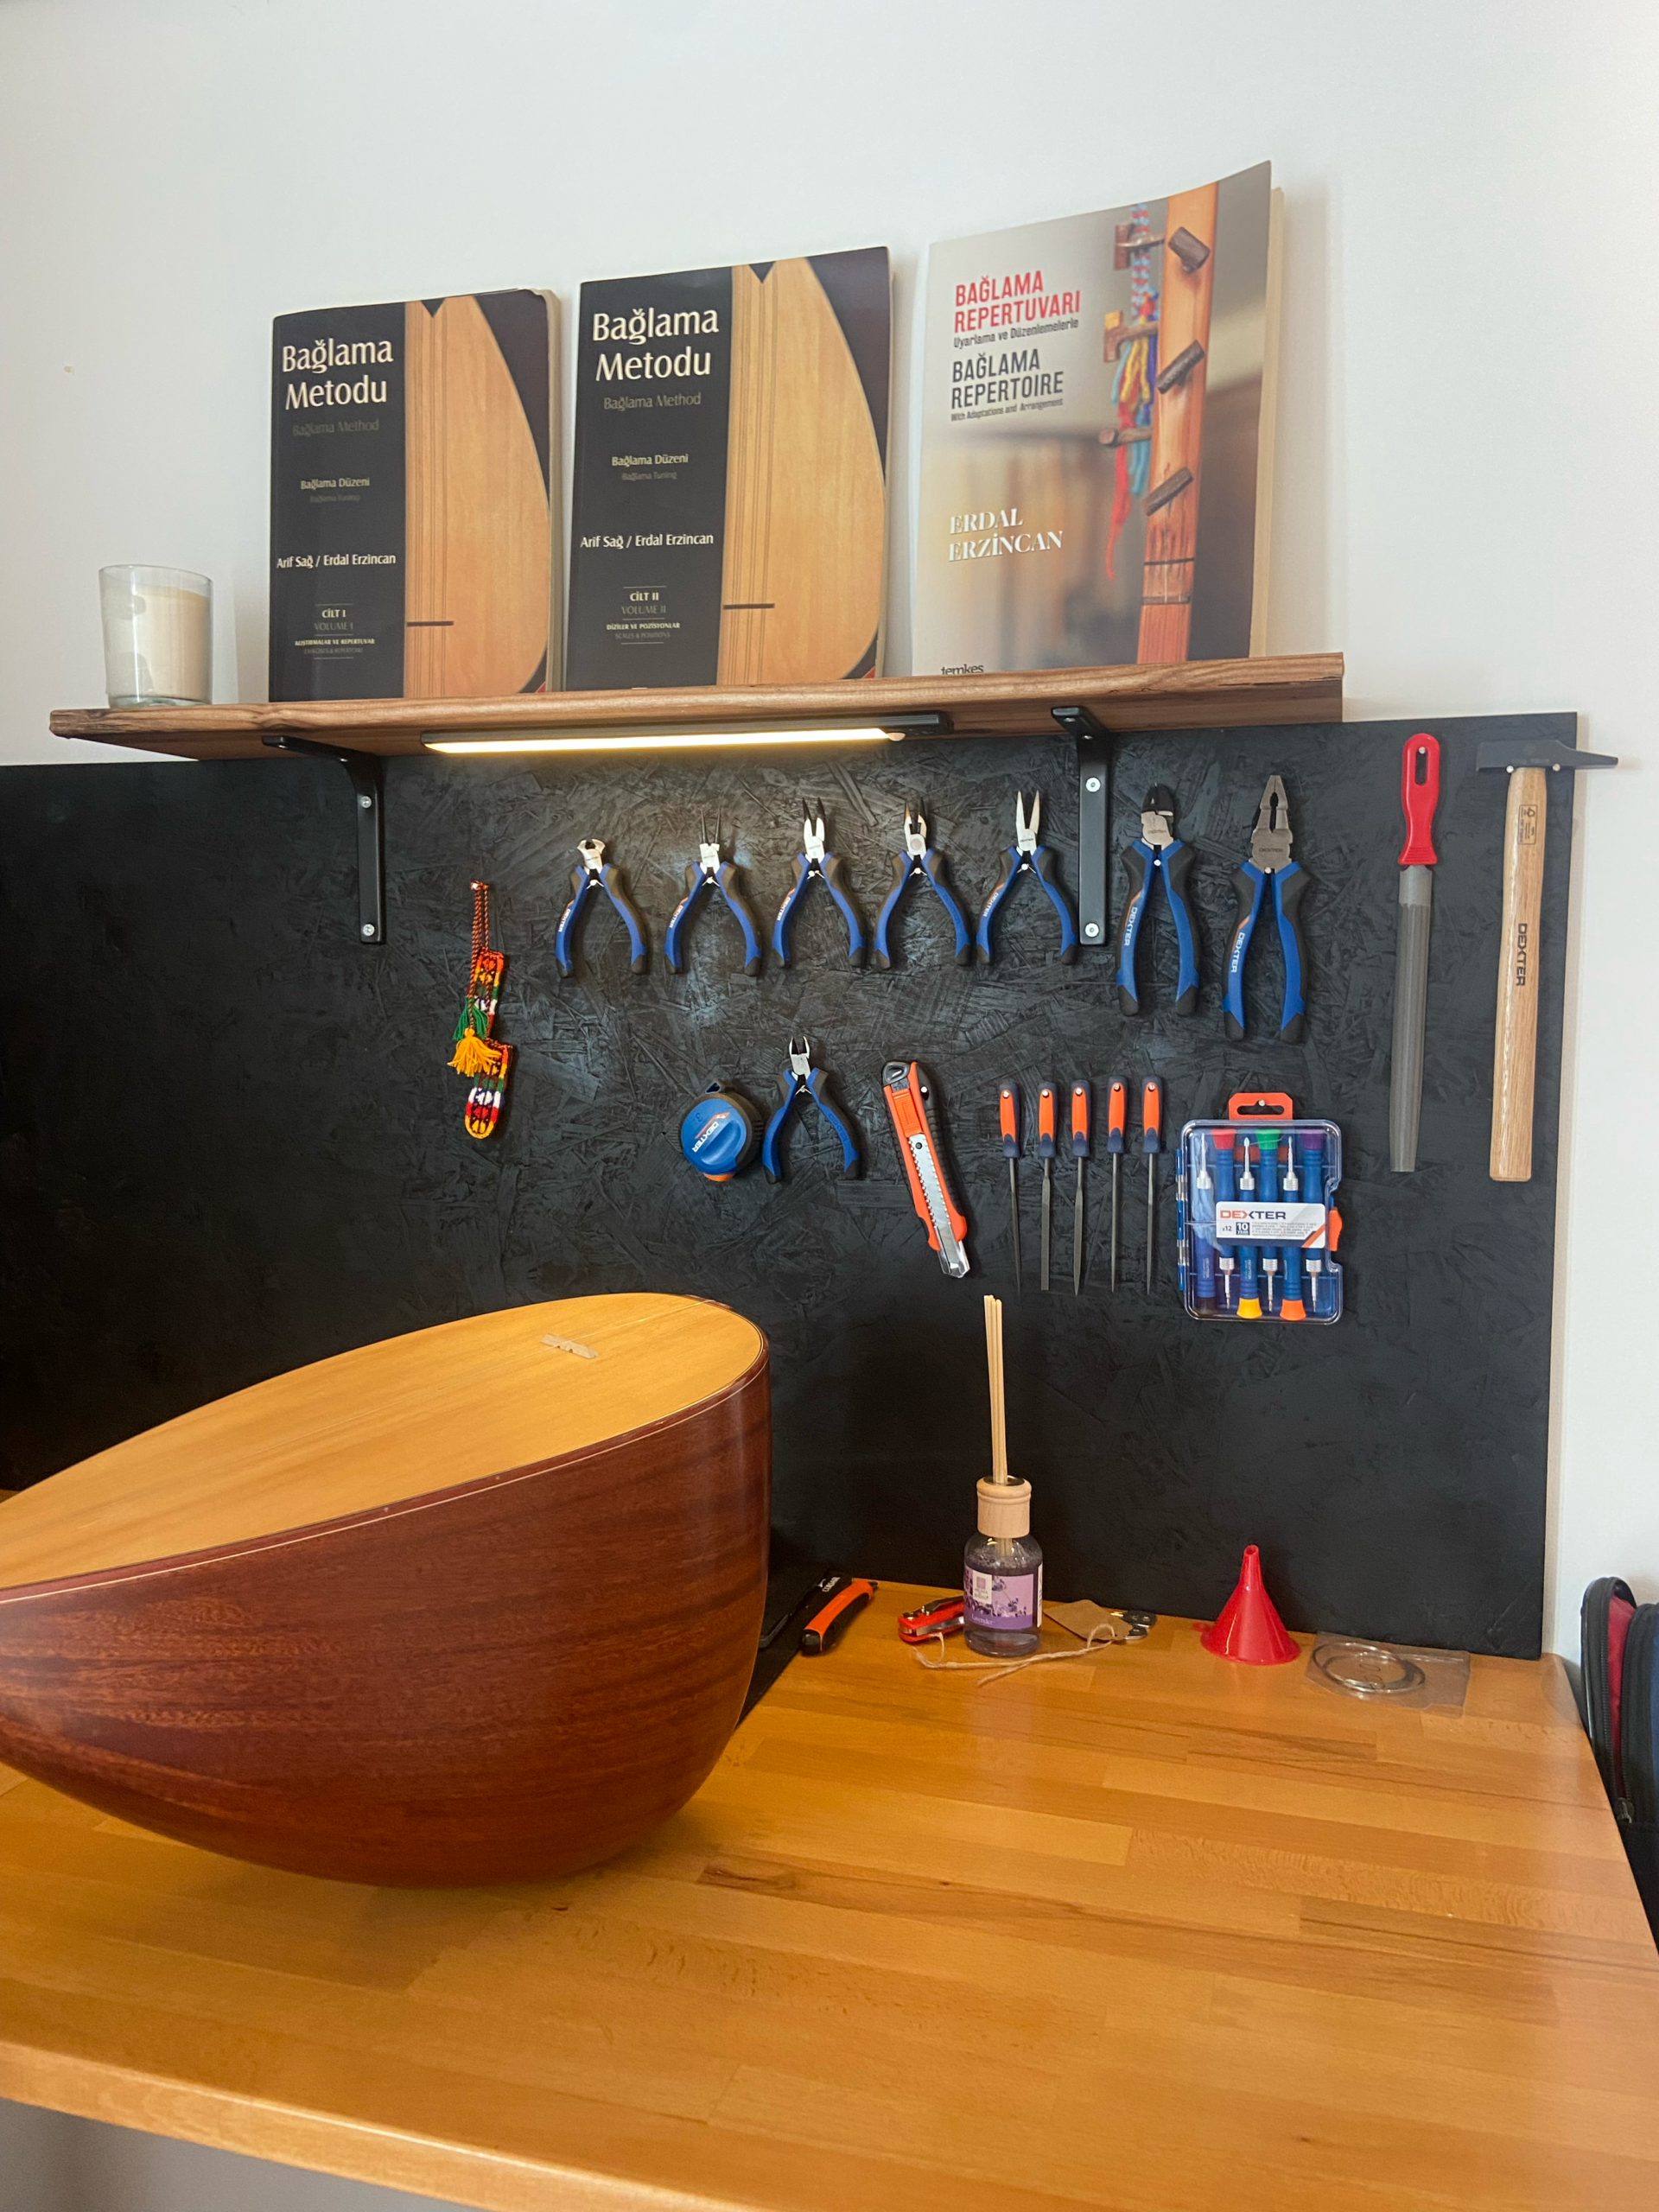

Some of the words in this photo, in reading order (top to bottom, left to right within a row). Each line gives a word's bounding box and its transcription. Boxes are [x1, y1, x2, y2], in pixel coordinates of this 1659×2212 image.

[956, 270, 1044, 307] BAĞLAMA
[955, 290, 1080, 334] REPERTUVARI
[593, 308, 719, 346] Bağlama
[954, 334, 995, 349] Uyarlama
[998, 331, 1008, 340] ve
[1010, 318, 1079, 339] Düzenlemelerle
[283, 338, 393, 373] Bağlama
[595, 346, 711, 381] Metodu
[952, 348, 1040, 383] BAĞLAMA
[285, 375, 387, 410] Metodu
[604, 397, 653, 411] Bağlama
[657, 391, 701, 407] Method
[951, 371, 1064, 410] REPERTOIRE
[950, 410, 965, 422] With
[967, 408, 1004, 420] Adaptations
[1005, 404, 1017, 414] and
[1020, 398, 1064, 410] Arrangement
[293, 423, 334, 437] Bağlama
[339, 418, 379, 432] Method
[612, 455, 652, 467] Bağlama
[654, 454, 689, 464] Düzeni
[301, 479, 337, 490] Bağlama
[339, 477, 370, 487] Düzeni
[950, 508, 1024, 535] ERDAL
[580, 536, 601, 548] Arif
[603, 535, 624, 550] Sağ
[626, 536, 632, 549] /
[635, 534, 663, 546] Erdal
[666, 534, 714, 545] Erzincan
[949, 531, 1064, 562] ERZİNCAN
[276, 556, 293, 569] Arif
[296, 556, 314, 569] Sağ
[315, 556, 321, 568] /
[323, 554, 349, 566] Erdal
[352, 554, 397, 565] Erzincan
[630, 591, 649, 601] CİLT
[652, 592, 659, 601] II
[321, 607, 340, 618] CİLT
[621, 606, 658, 614] VOLUME
[314, 622, 348, 631] VOLUME
[941, 664, 984, 675] temkes
[982, 892, 999, 917] DEXTER
[1124, 906, 1138, 946] DEXTER
[1230, 932, 1245, 973] DEXTER
[1516, 923, 1528, 986] DEXTER
[692, 1121, 720, 1153] DEXTER
[1220, 1210, 1287, 1219] DEXTER
